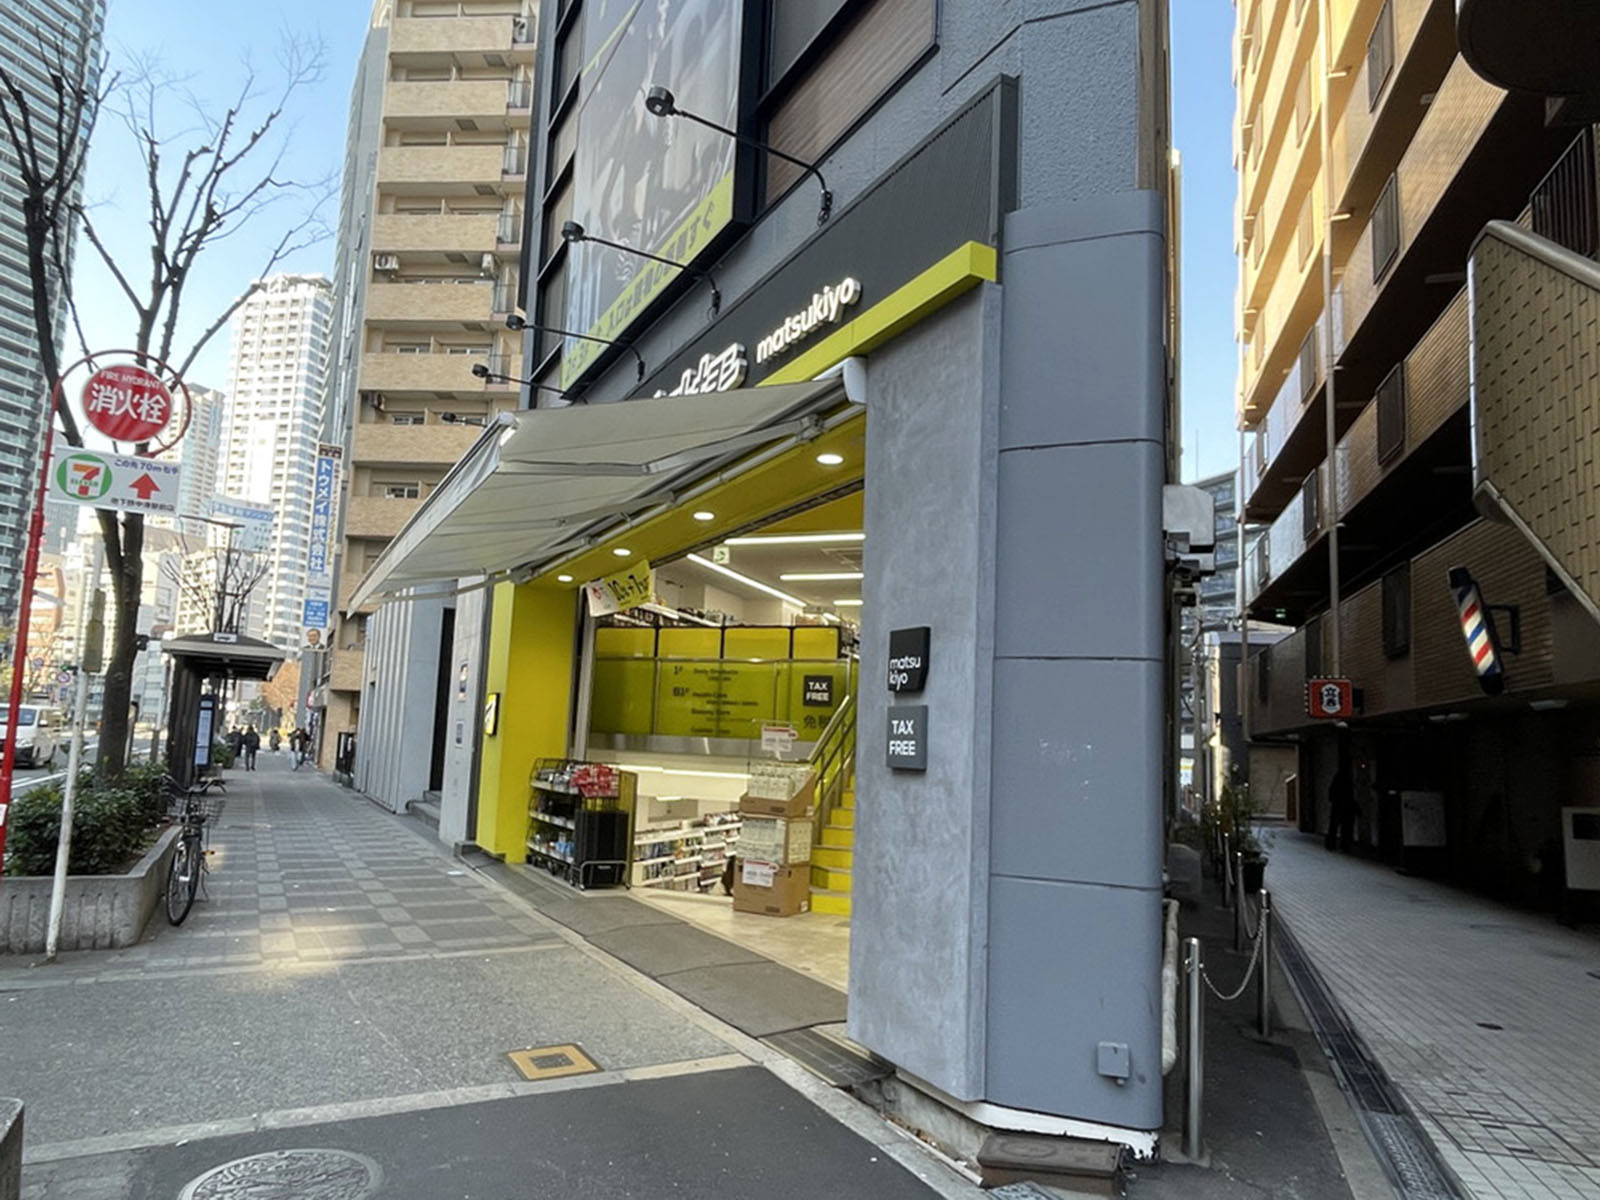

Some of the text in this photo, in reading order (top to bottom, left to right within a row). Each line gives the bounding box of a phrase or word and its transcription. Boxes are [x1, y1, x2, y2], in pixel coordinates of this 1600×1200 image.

[756, 276, 857, 364] matsukiyo
[89, 383, 166, 424] 消火栓
[889, 656, 921, 670] matsu
[807, 681, 828, 691] TAX
[889, 671, 908, 691] kiyo
[805, 691, 830, 702] FREE
[891, 719, 914, 735] TAX
[888, 740, 917, 756] FREE
